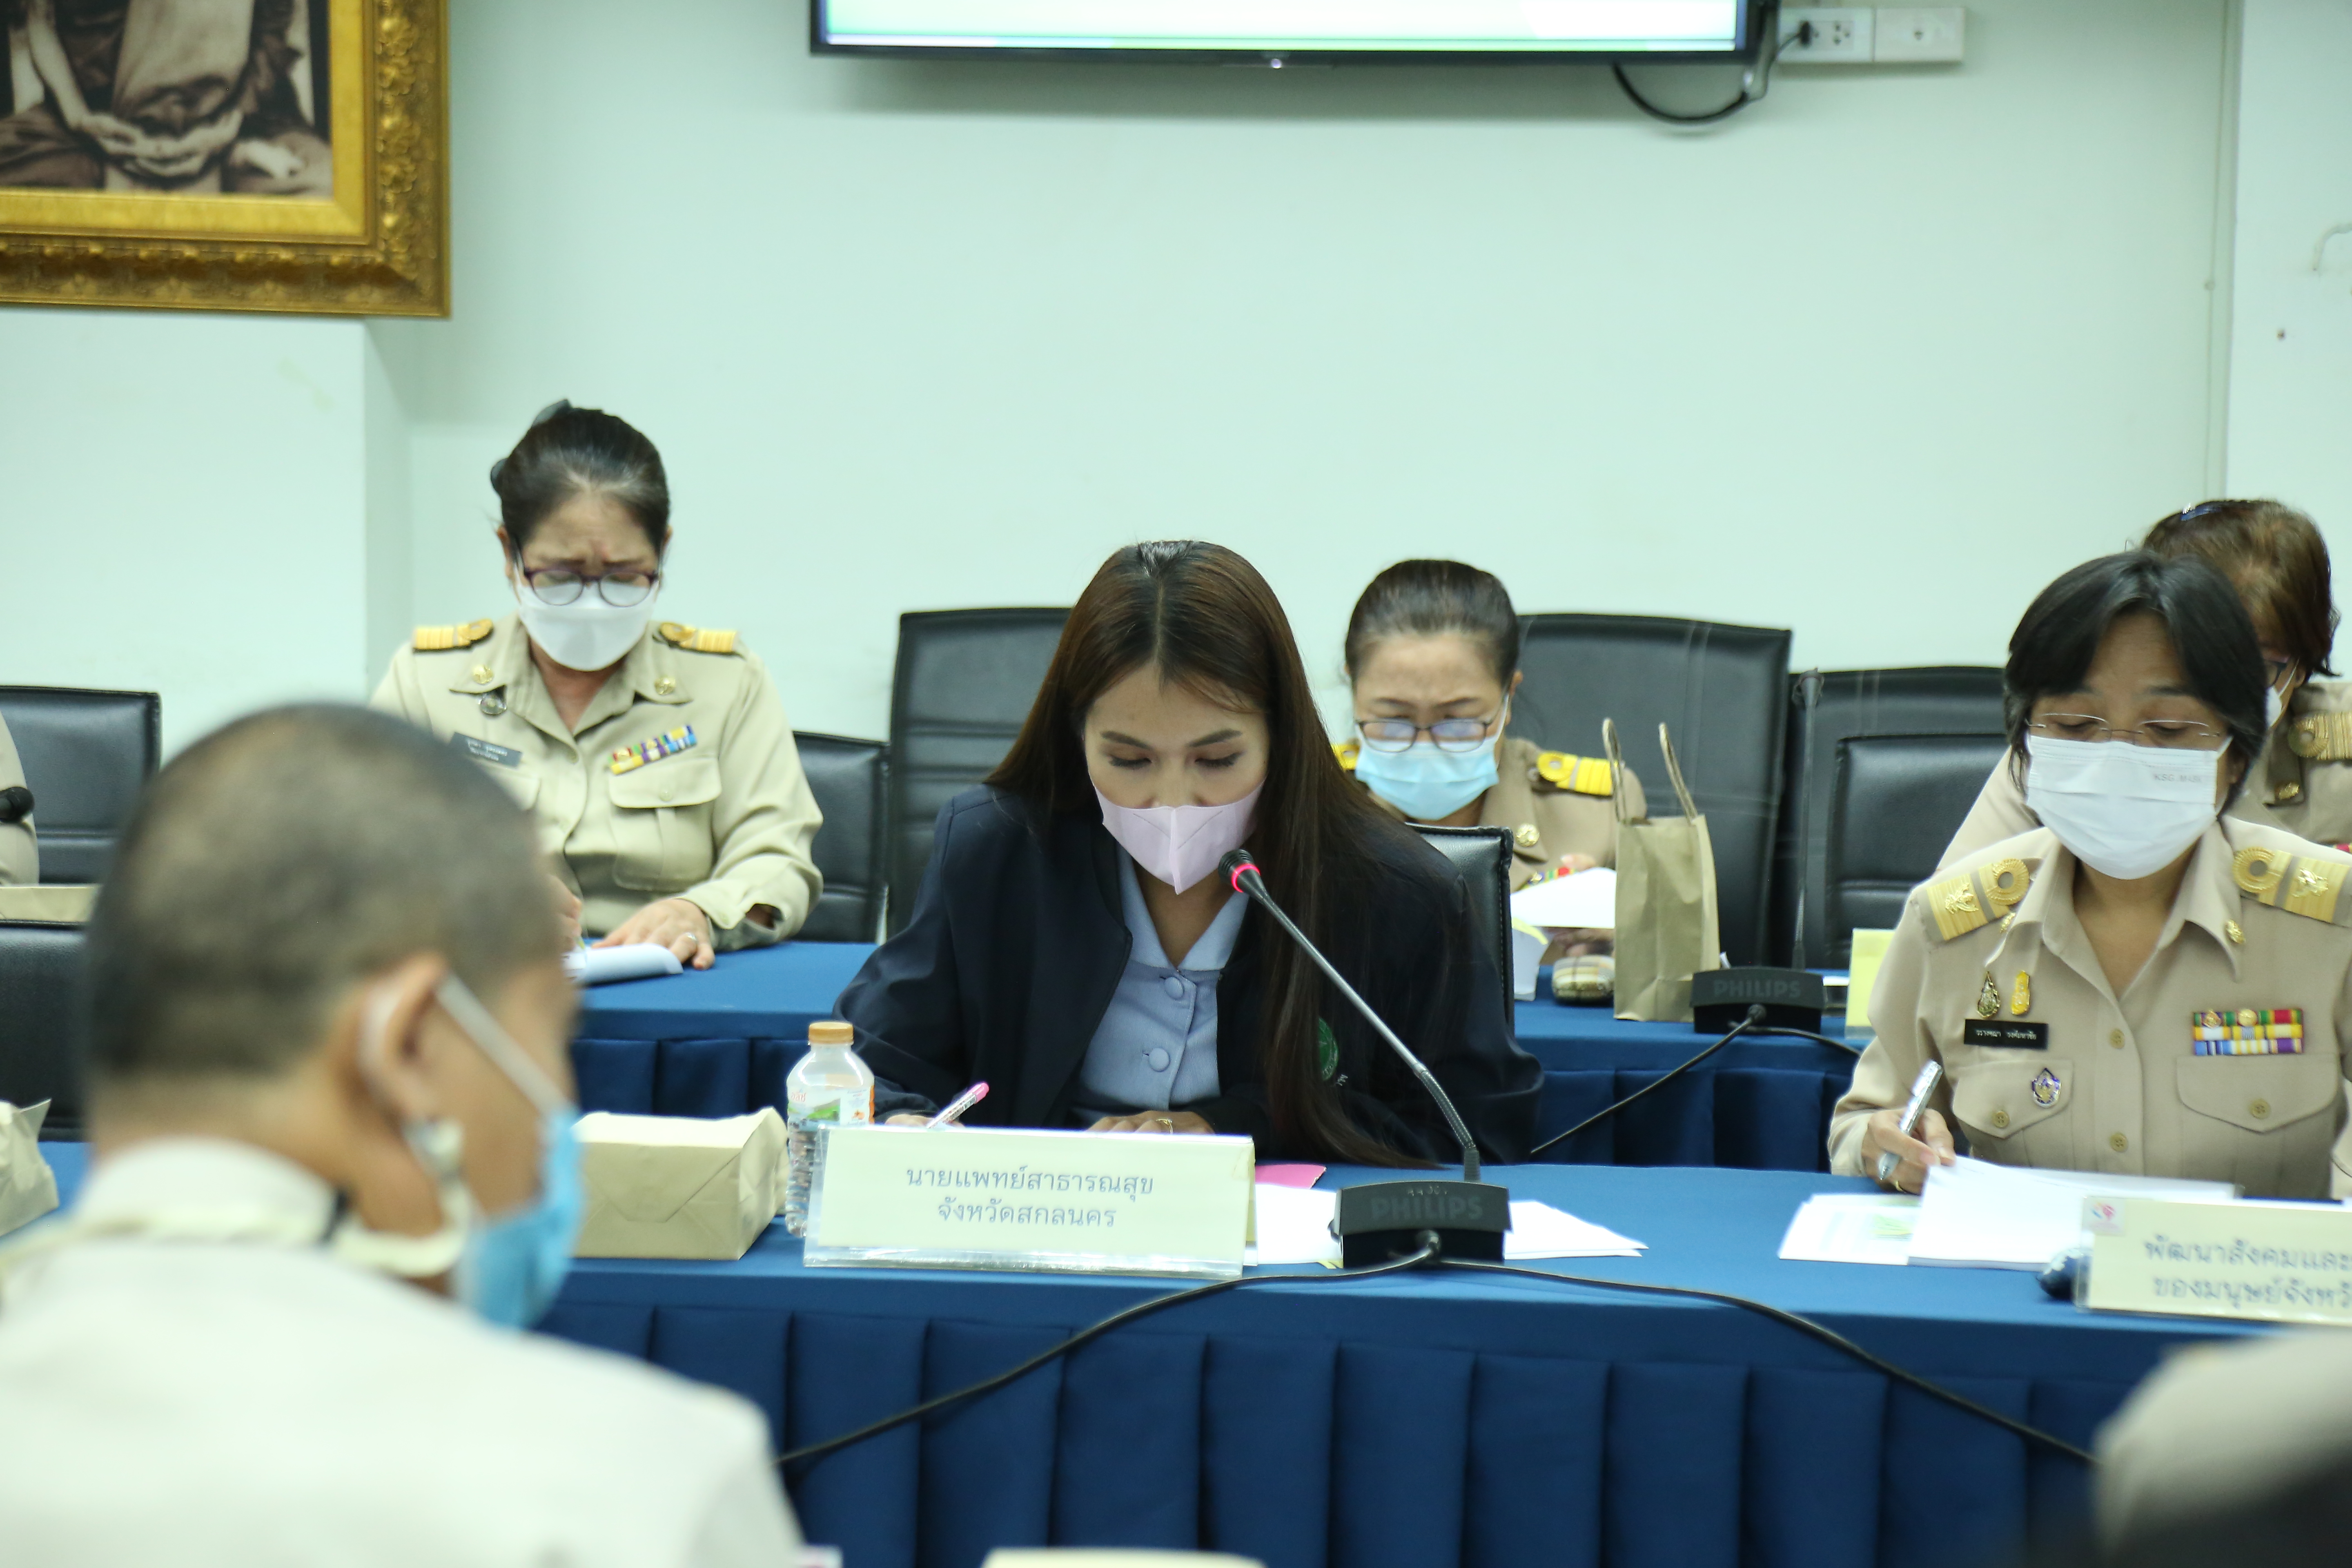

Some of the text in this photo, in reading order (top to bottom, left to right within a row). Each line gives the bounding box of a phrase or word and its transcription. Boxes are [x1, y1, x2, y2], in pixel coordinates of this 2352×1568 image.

[1714, 980, 1801, 998] PHILIPS
[906, 1165, 1154, 1202] นายแพทย์สาธารณสุข
[938, 1196, 1116, 1227] จังหวัดสกลนคร
[1371, 1196, 1483, 1220] PHILIPS
